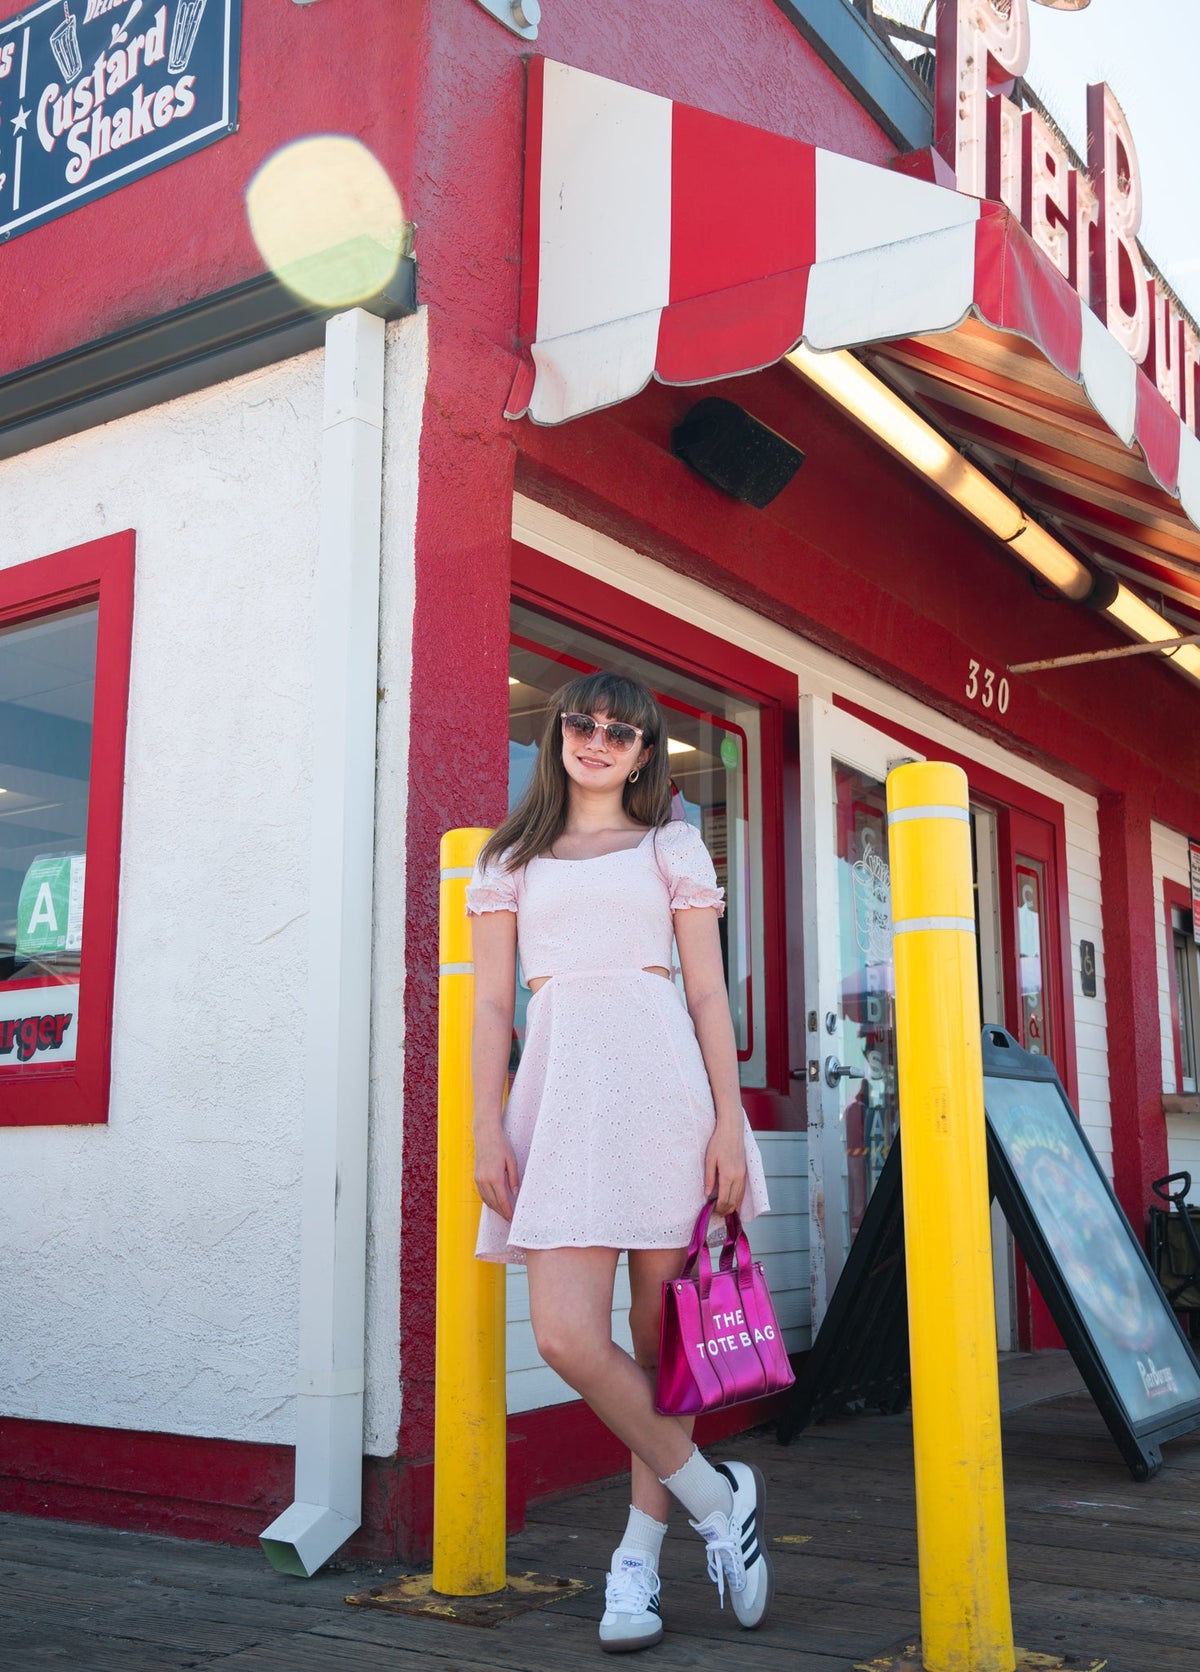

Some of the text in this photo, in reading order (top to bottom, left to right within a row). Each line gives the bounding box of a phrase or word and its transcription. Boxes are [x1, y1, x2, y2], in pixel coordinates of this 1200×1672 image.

[37, 5, 168, 153] Custard
[65, 75, 196, 184] Shakes
[965, 658, 1009, 714] 330
[27, 882, 58, 934] A
[696, 1325, 775, 1359] TOTE BAG
[713, 1309, 744, 1330] THE
